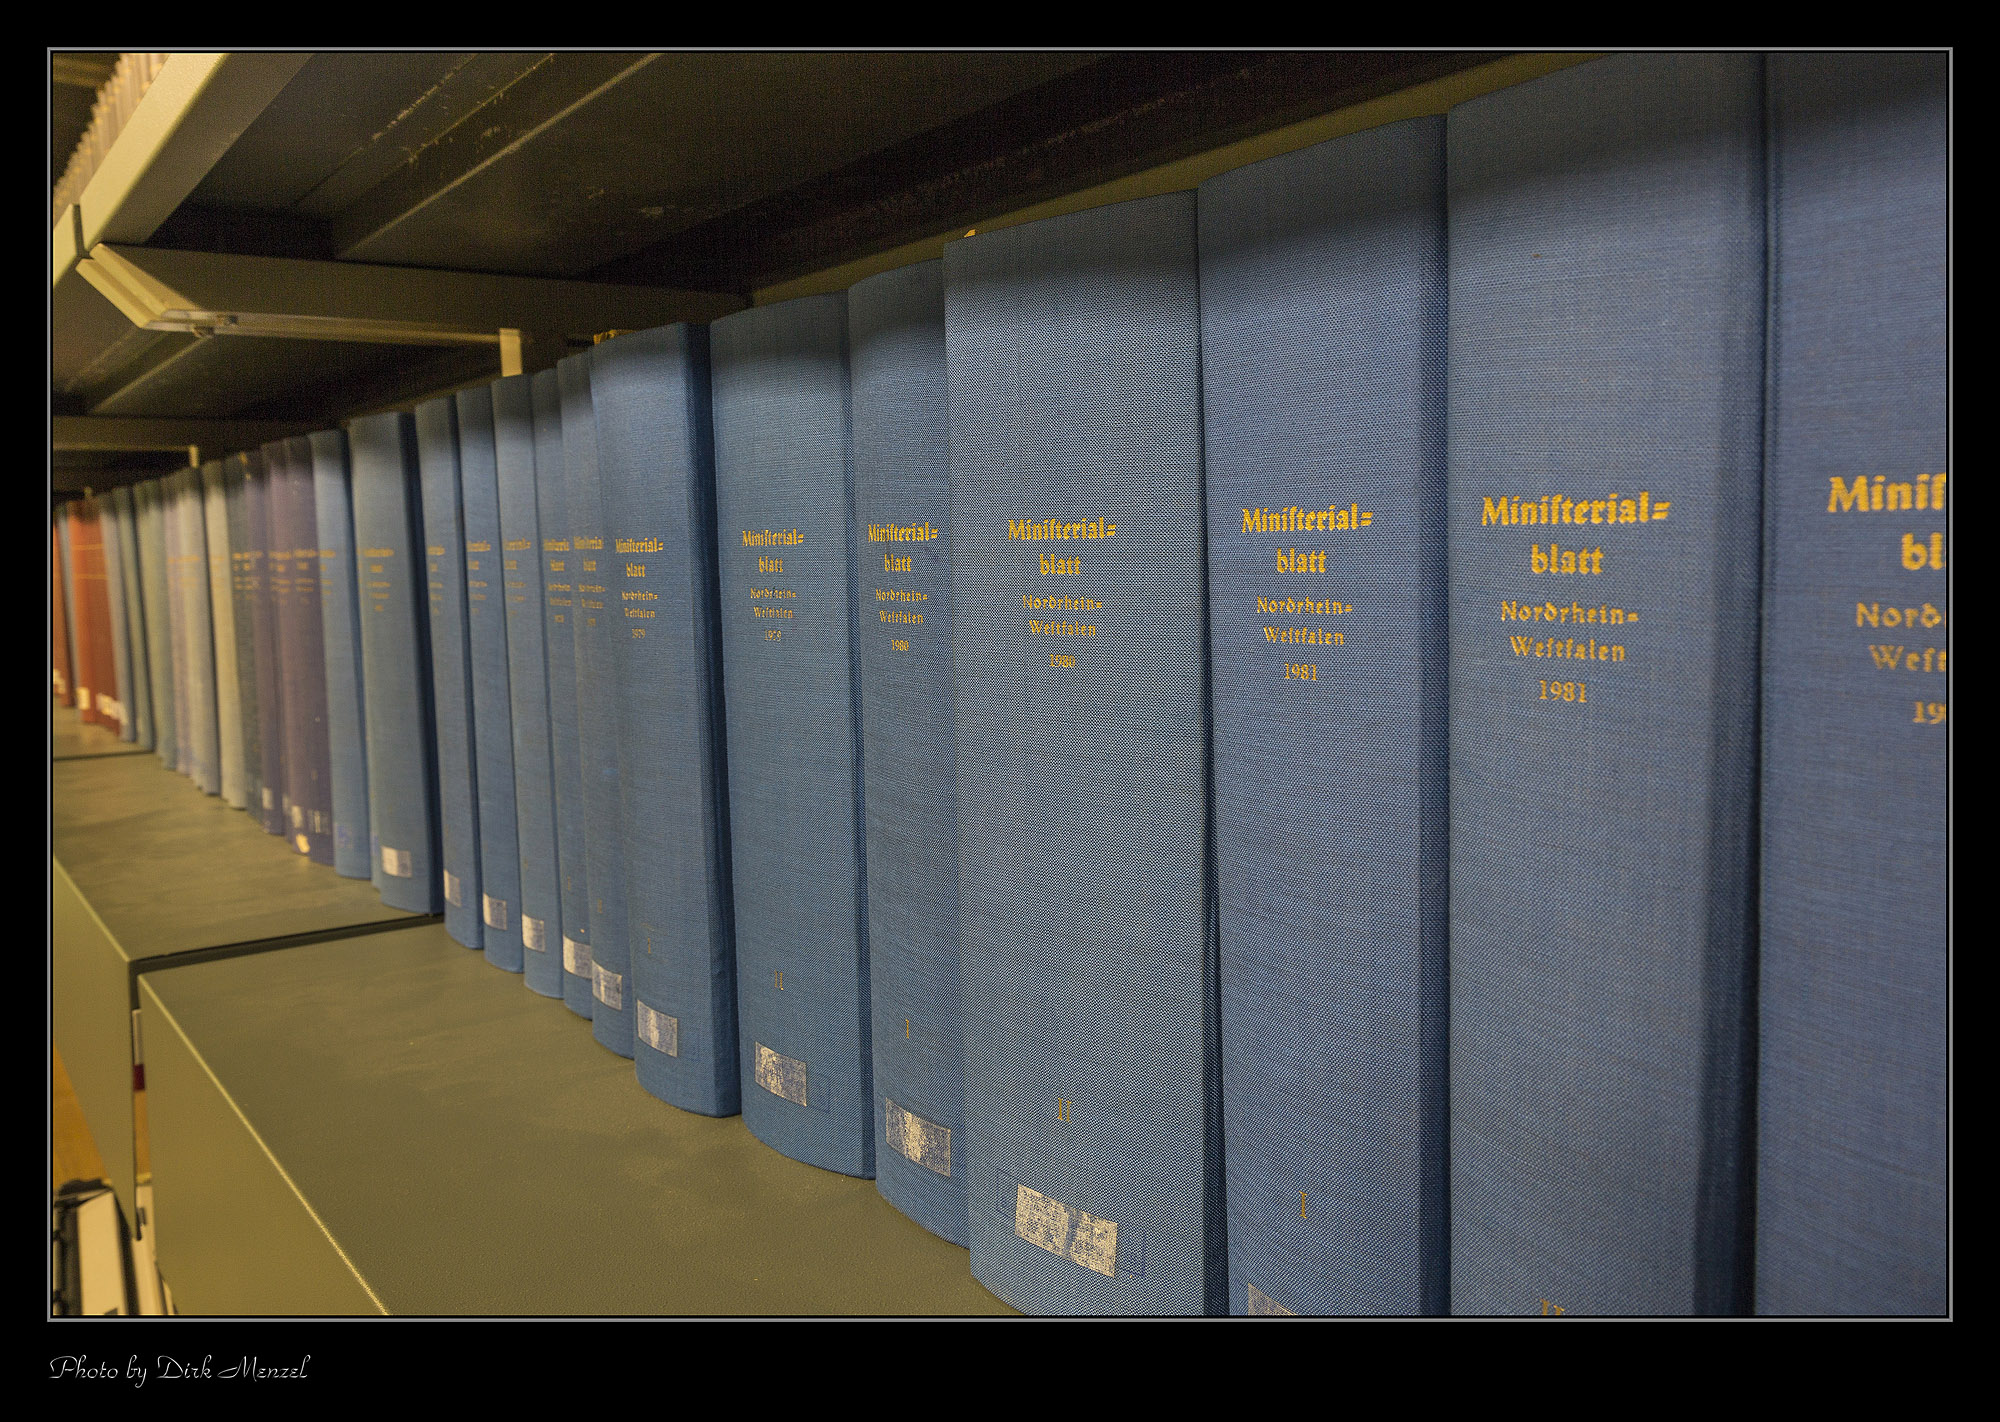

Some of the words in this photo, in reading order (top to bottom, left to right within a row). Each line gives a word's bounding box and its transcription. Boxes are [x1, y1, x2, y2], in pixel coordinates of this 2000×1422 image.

[759, 556, 783, 573] blatt
[885, 554, 912, 572] blatt
[1040, 554, 1081, 575] blatt
[1277, 548, 1327, 573] blatt
[1532, 544, 1605, 575] blatt
[626, 562, 646, 577] blatt
[1857, 603, 1946, 628] Nord
[891, 639, 911, 652] 1980
[1049, 653, 1077, 669] 1980
[1285, 663, 1317, 681] 1981
[1540, 680, 1587, 703] 1981
[1914, 702, 1946, 724] 19
